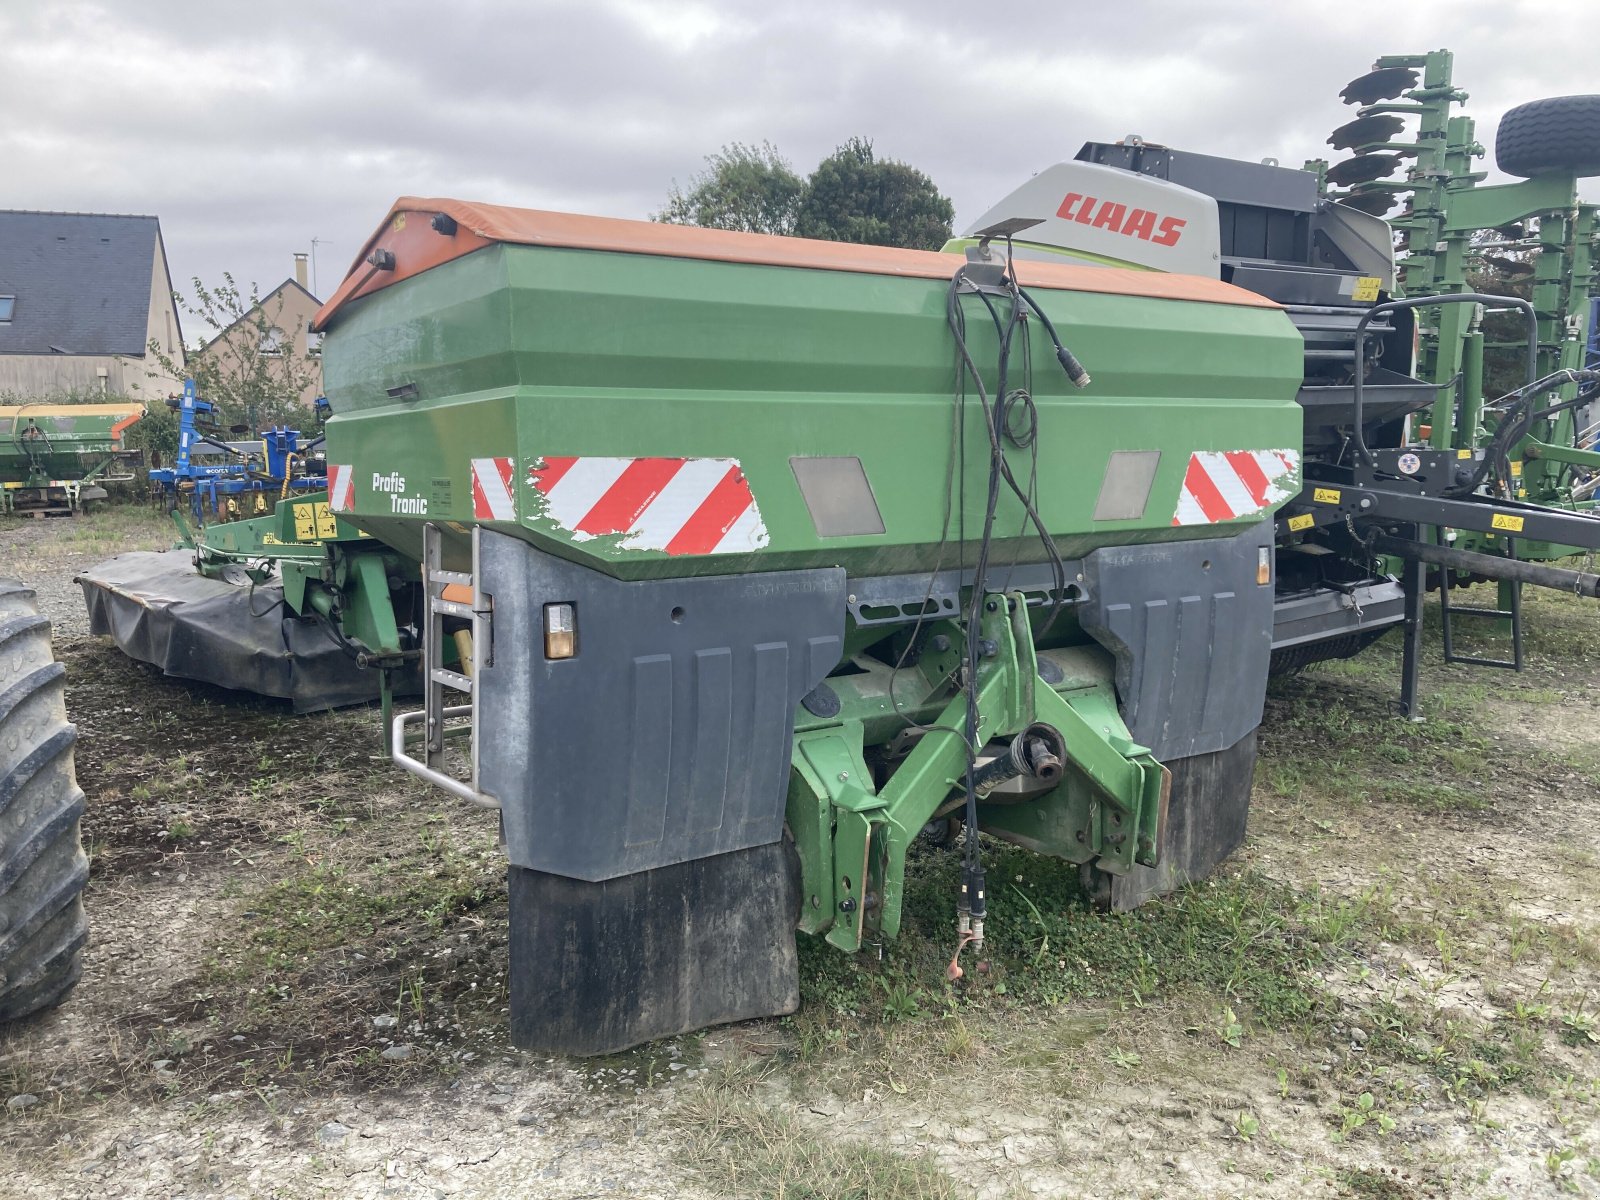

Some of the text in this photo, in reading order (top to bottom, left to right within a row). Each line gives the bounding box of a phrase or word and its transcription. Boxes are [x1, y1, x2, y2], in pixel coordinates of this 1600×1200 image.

[1056, 192, 1187, 247] CLAAS
[372, 472, 406, 493] Profis
[390, 493, 428, 515] Tronic
